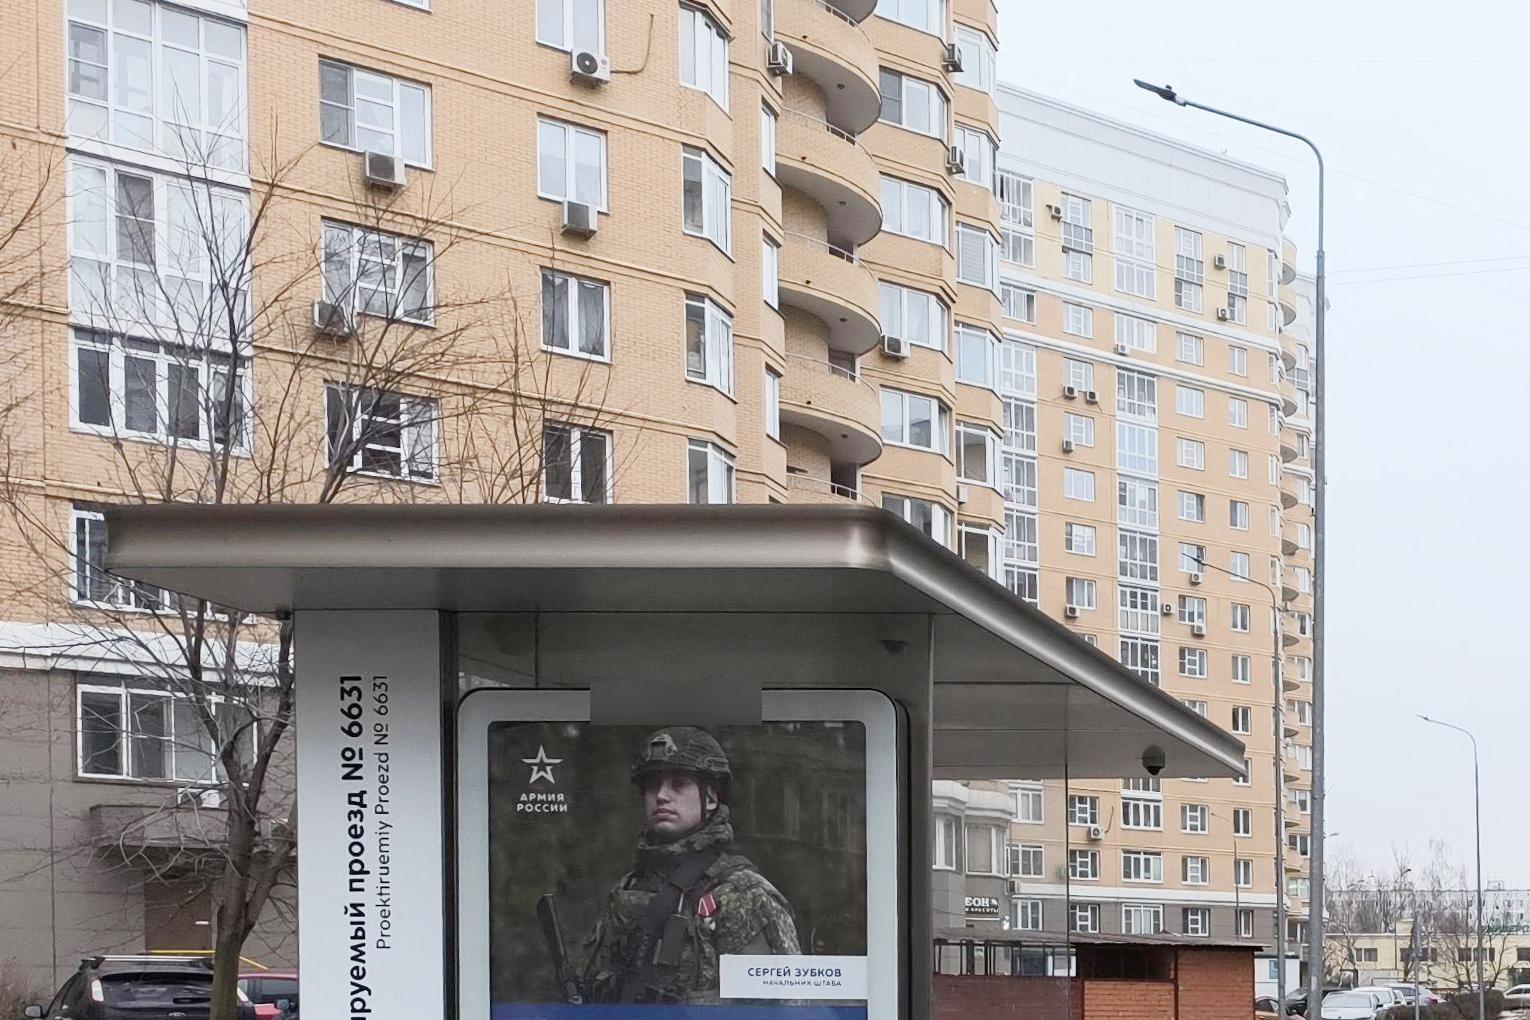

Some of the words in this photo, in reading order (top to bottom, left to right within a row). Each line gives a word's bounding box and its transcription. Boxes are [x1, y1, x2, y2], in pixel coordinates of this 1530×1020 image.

[340, 675, 363, 738] 6631
[373, 675, 389, 716] 6631
[374, 722, 389, 745] №
[341, 747, 364, 781] №
[374, 752, 390, 815] Proezd
[519, 793, 565, 802] АРМИЯ
[516, 803, 568, 813] РОССИИ
[348, 790, 370, 892] проезд
[375, 820, 393, 949] Proektiruemiy
[747, 966, 791, 977] СЕРГЕЙ
[795, 967, 842, 978] ЗУБКОВ
